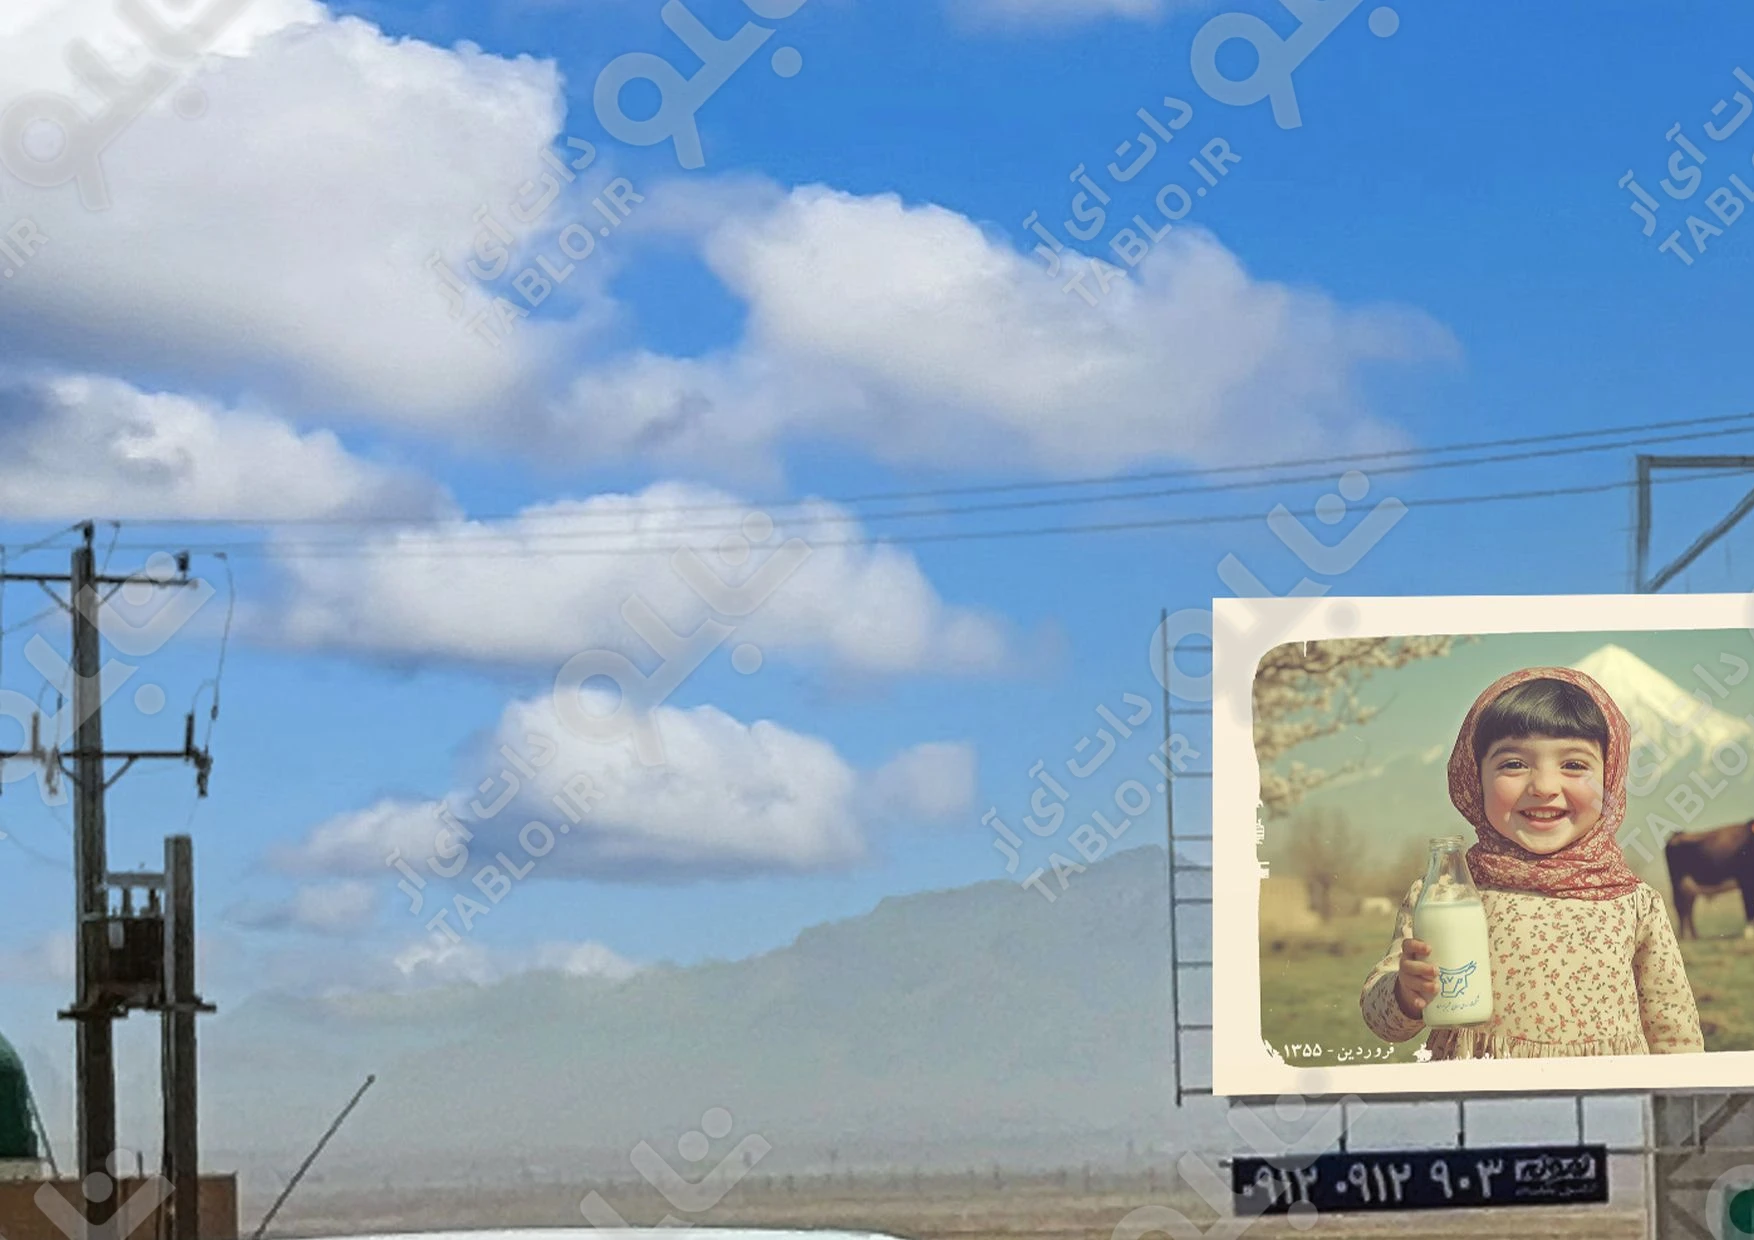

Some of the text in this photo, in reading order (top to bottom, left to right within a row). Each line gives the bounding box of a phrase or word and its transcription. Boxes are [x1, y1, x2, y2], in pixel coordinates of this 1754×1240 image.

[1284, 1042, 1395, 1062] فروردین ۱۳۵۵
[1336, 1162, 1412, 1203] ۰۹۱۲
[1430, 1159, 1503, 1200] ۹۰۳
